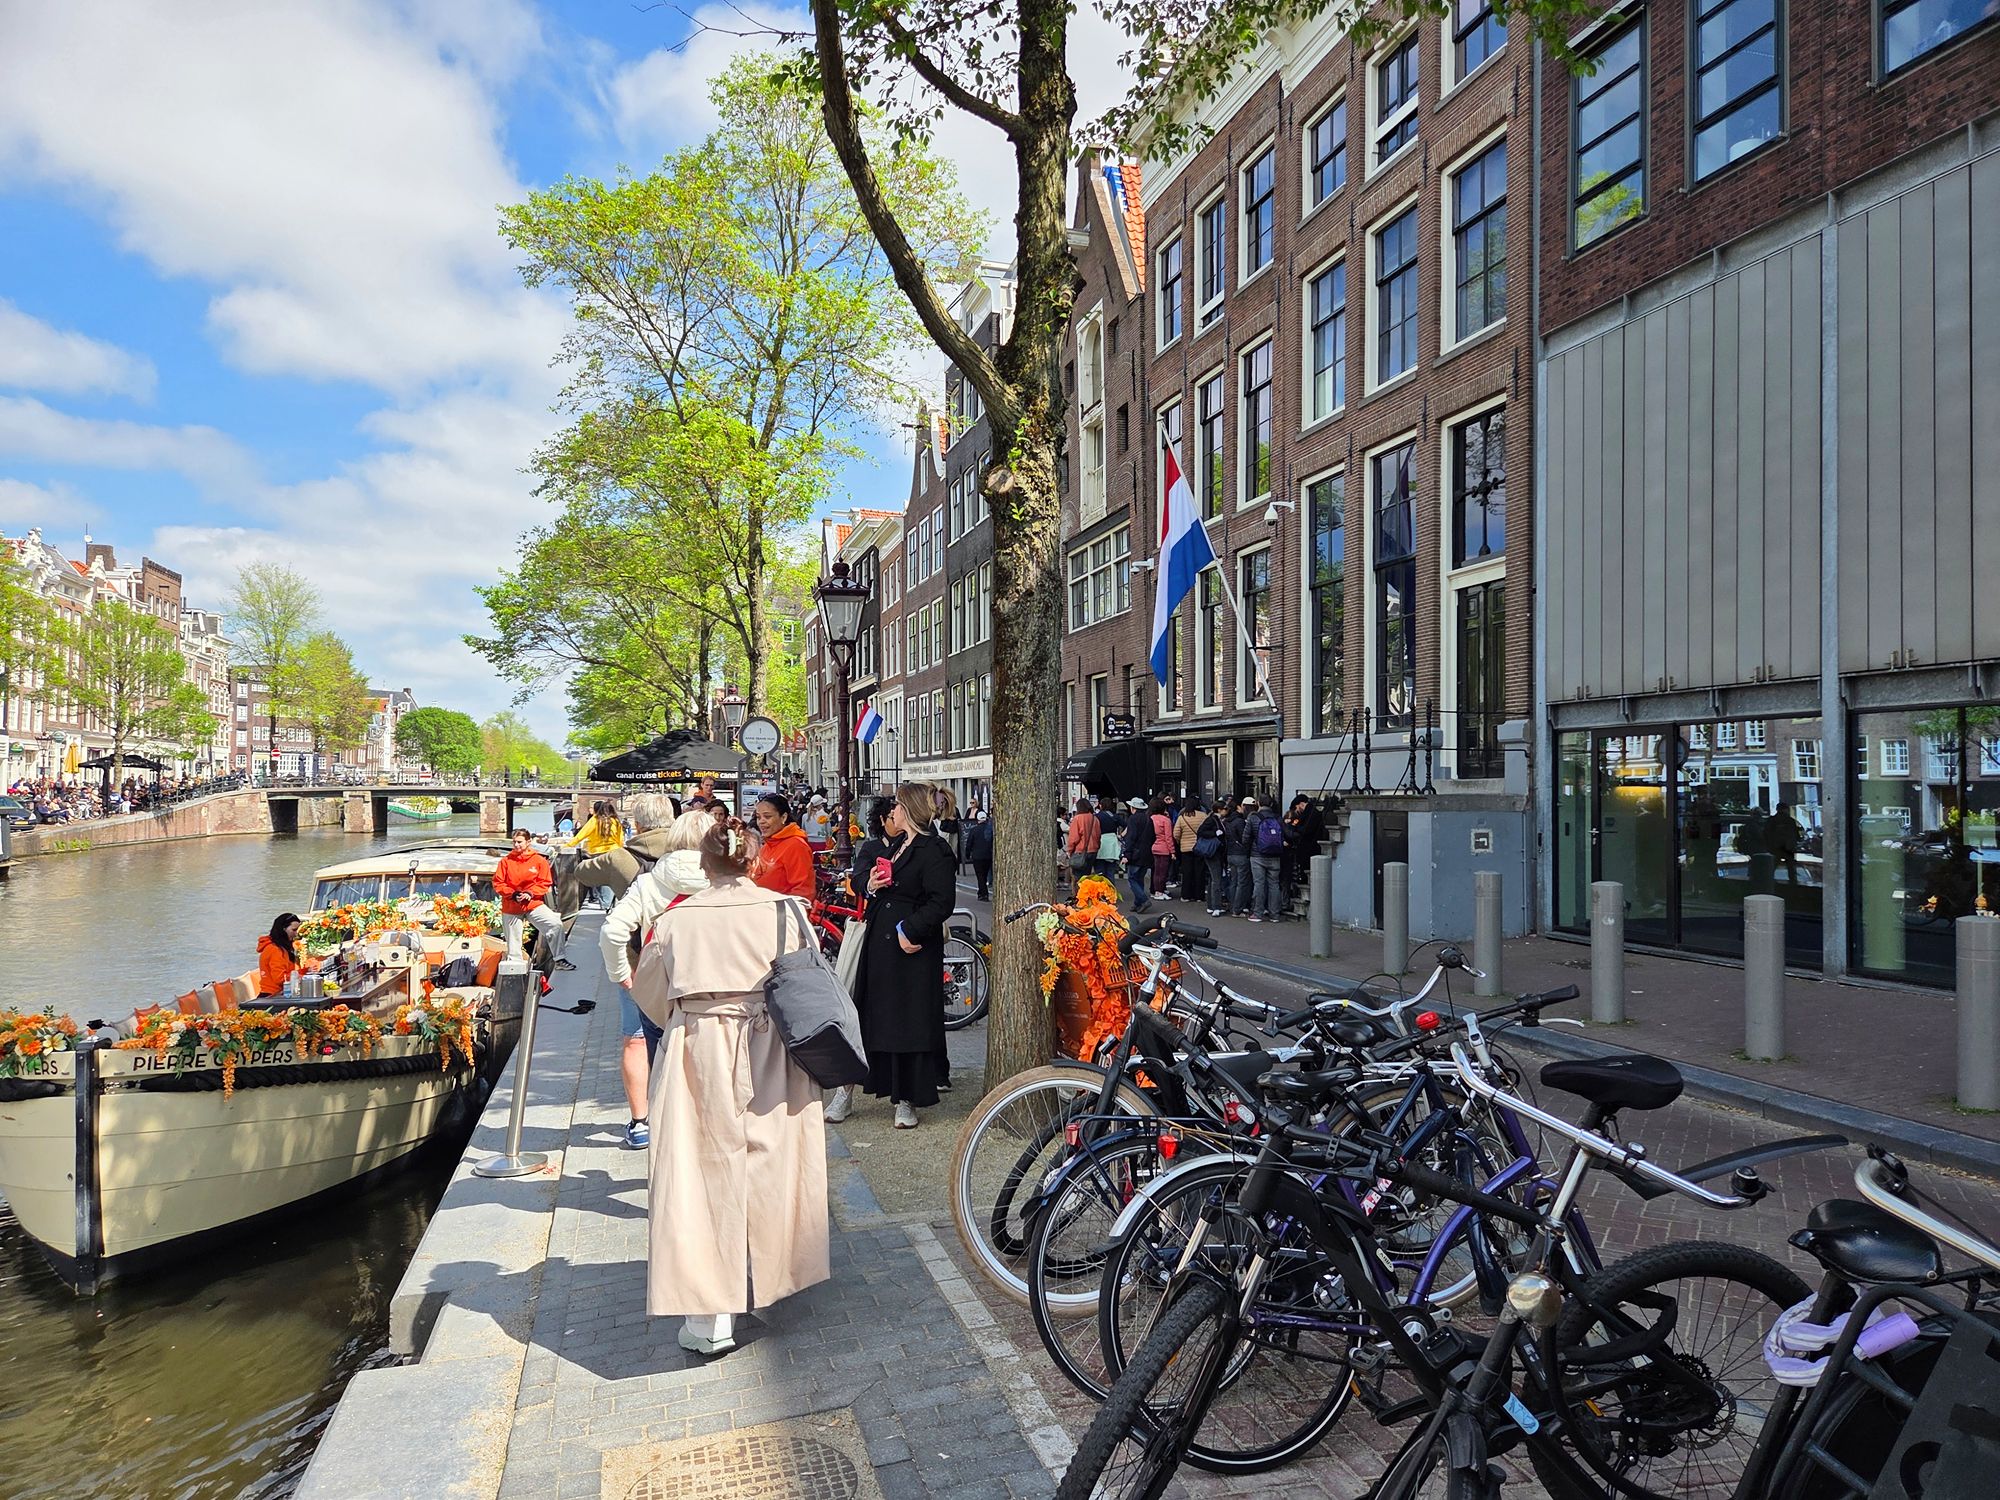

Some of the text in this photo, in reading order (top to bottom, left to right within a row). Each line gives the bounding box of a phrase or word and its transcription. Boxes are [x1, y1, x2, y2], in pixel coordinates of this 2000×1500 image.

[635, 771, 657, 779] cruise
[657, 770, 682, 778] tickets
[720, 771, 738, 779] canal
